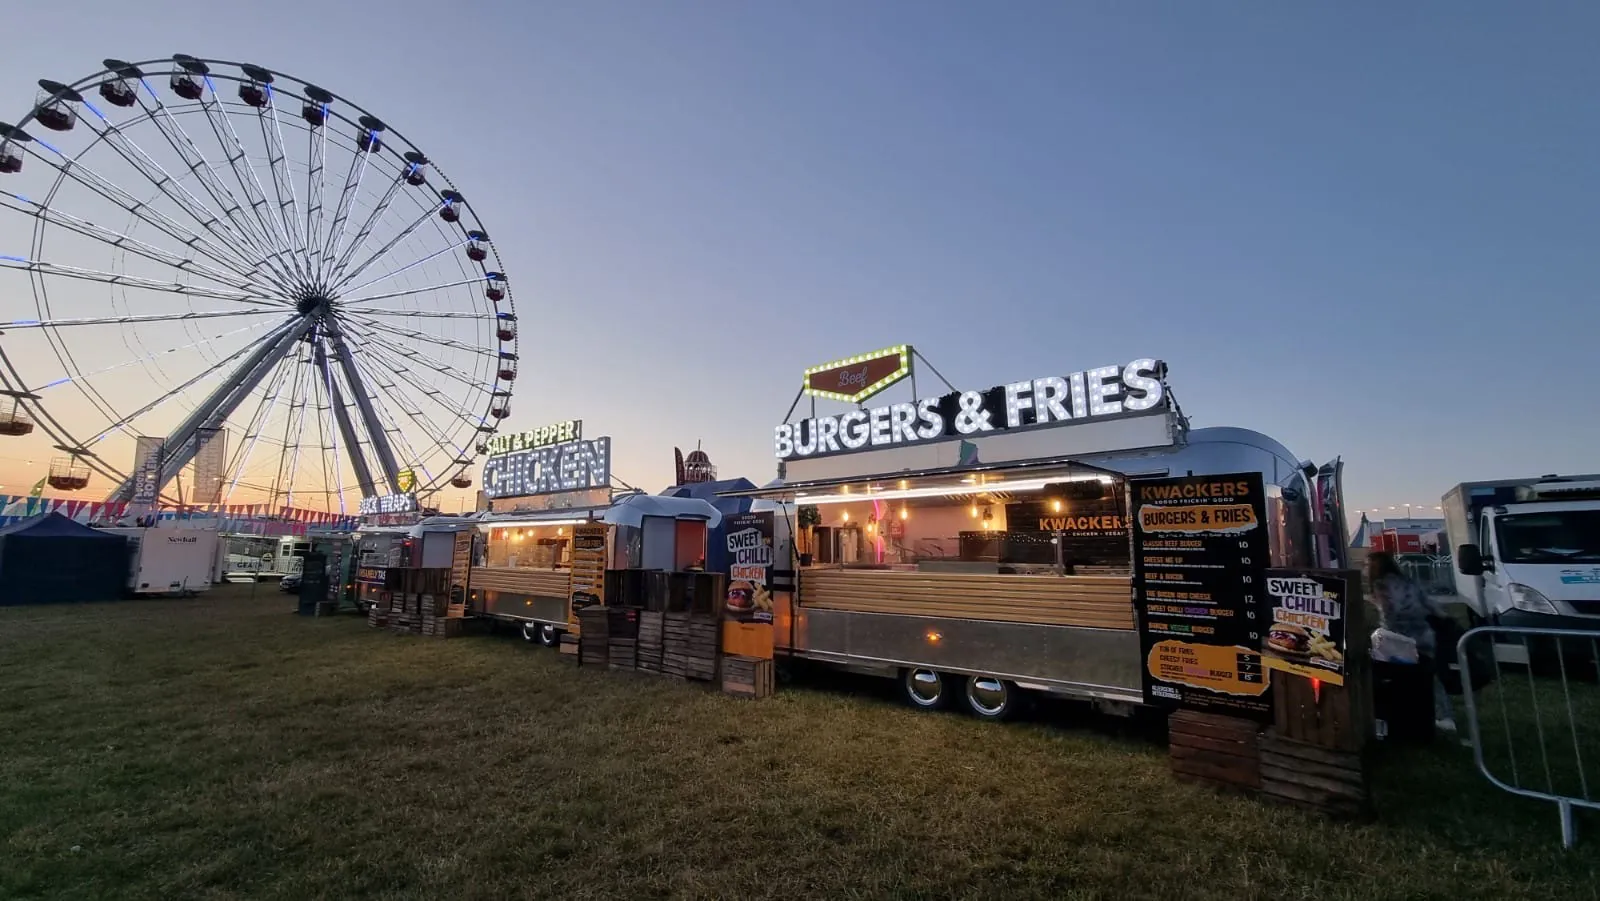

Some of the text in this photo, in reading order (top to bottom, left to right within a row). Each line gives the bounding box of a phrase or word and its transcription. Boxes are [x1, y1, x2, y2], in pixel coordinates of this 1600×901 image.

[838, 366, 868, 387] Beef
[773, 358, 1165, 459] BURGERS & FRIES
[486, 420, 575, 456] SALT & PEPPER
[482, 437, 608, 499] CHICKEN
[1141, 481, 1250, 499] KWACKERS
[380, 492, 411, 513] WRAPS
[1143, 508, 1251, 526] BURGERS & FRIES
[168, 536, 197, 544] Newhall
[728, 531, 760, 549] SWEET
[738, 548, 770, 564] CHILLI
[732, 566, 764, 580] CHICKEN
[1270, 580, 1318, 596] SWEET
[1245, 595, 1256, 604] 12
[1285, 596, 1335, 617] CHILLI
[1247, 611, 1255, 619] 10
[1276, 609, 1326, 629] CHICKEN
[1249, 632, 1258, 640] 10
